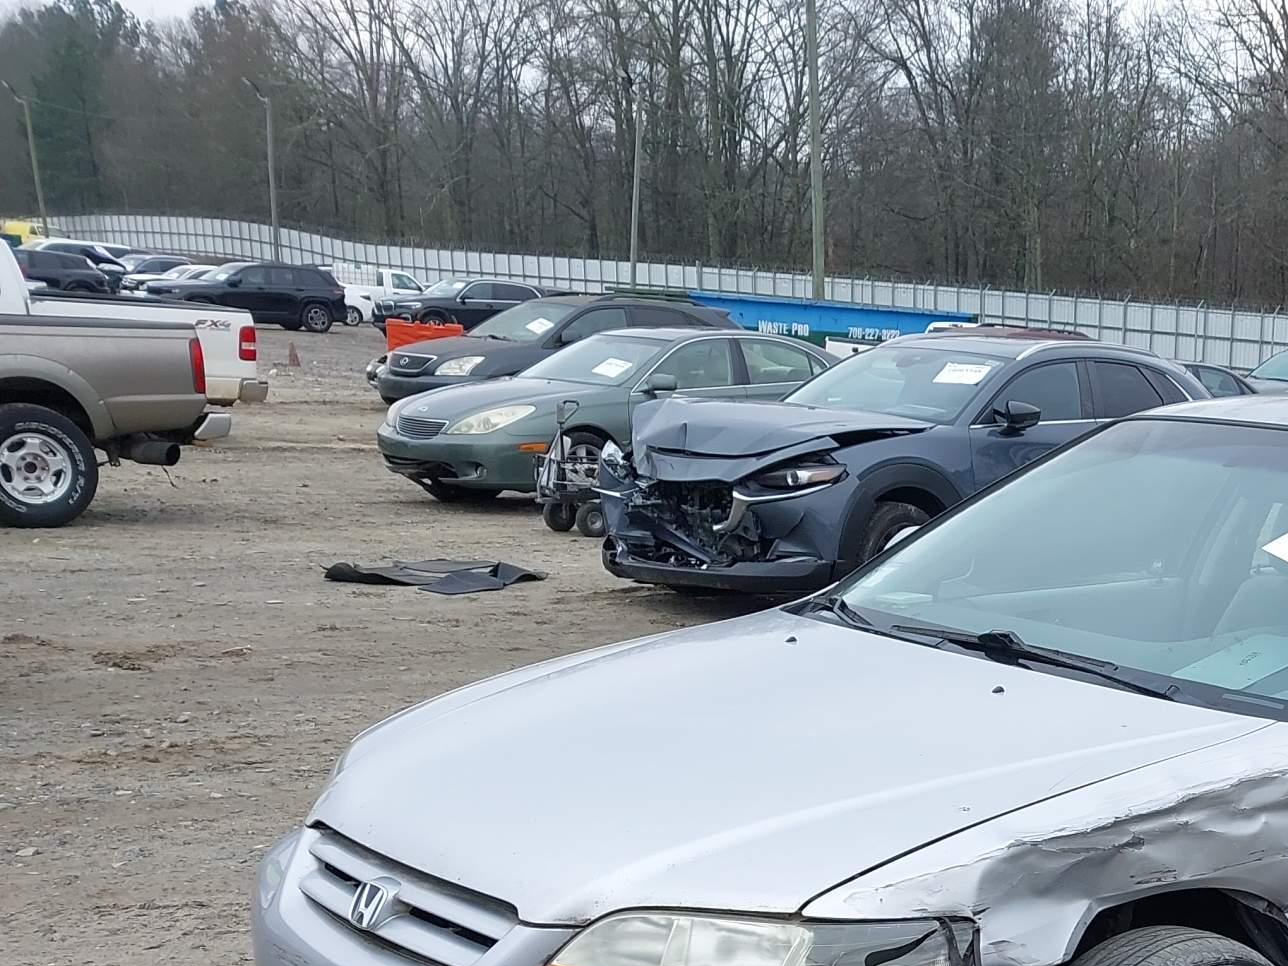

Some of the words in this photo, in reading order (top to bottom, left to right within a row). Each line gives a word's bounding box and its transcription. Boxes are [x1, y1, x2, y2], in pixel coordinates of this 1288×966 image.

[195, 319, 231, 328] FX4
[758, 320, 788, 335] WASTE
[791, 322, 809, 337] PRO
